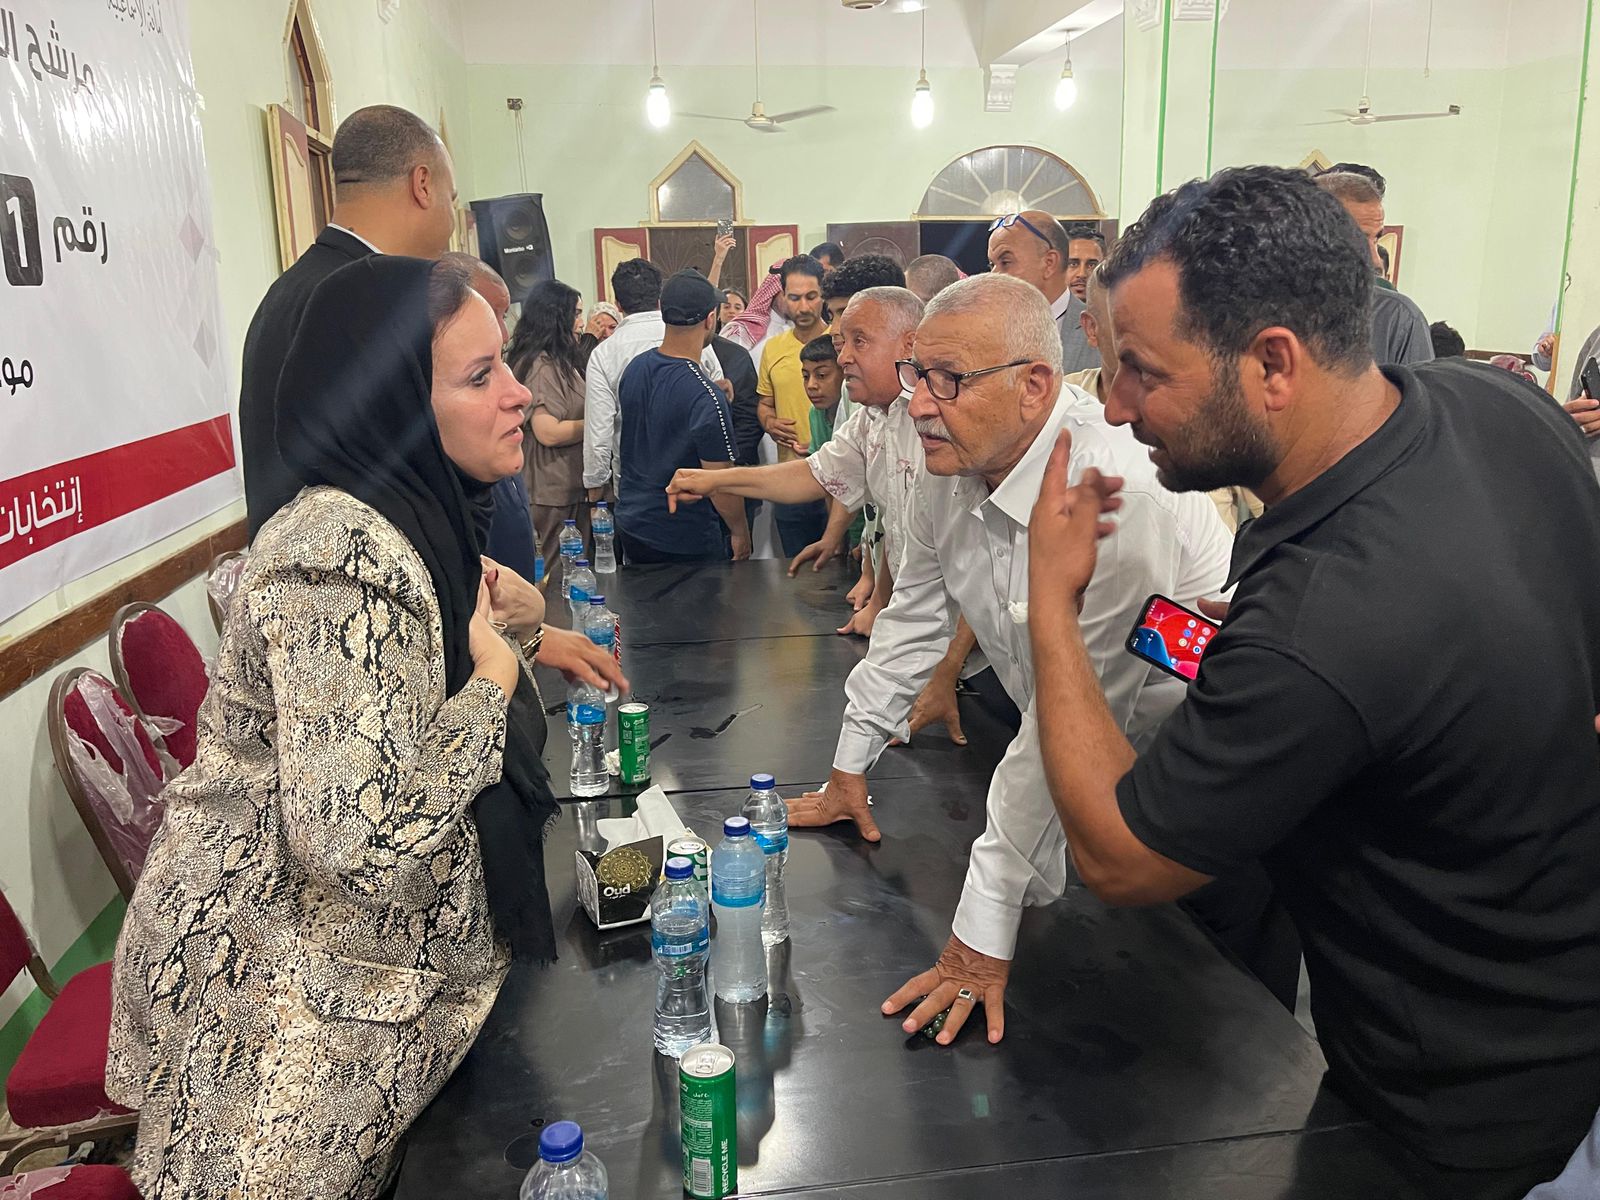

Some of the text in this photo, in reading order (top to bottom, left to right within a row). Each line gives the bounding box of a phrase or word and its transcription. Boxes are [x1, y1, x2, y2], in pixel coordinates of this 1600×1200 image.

[25, 19, 96, 96] مرشح
[6, 196, 108, 268] رقم 1
[603, 883, 631, 897] Oud
[720, 1138, 729, 1194] RECYCLE ME
